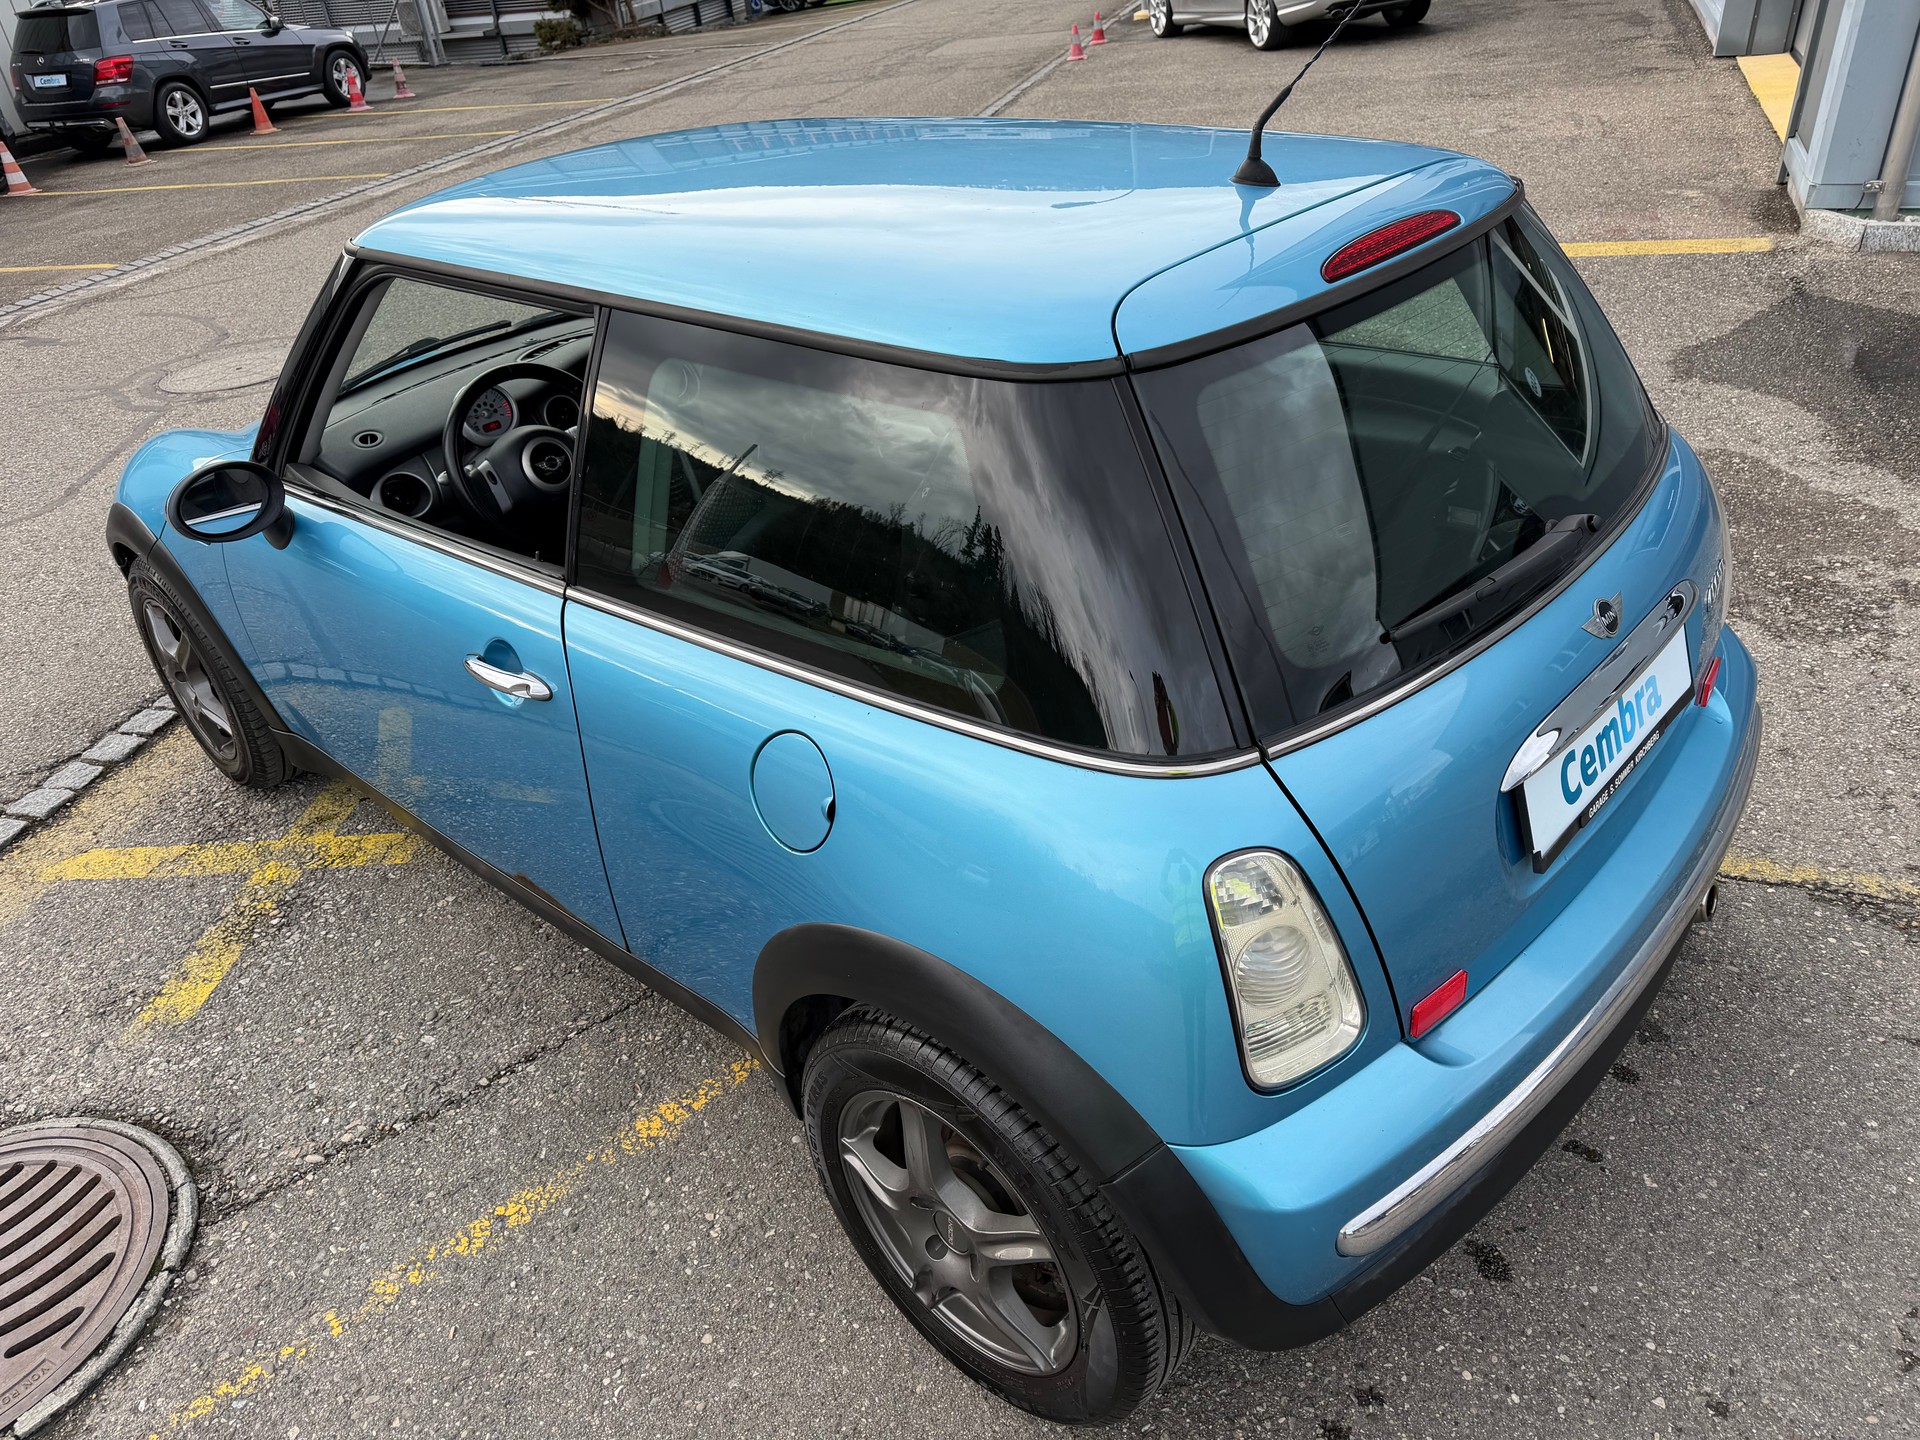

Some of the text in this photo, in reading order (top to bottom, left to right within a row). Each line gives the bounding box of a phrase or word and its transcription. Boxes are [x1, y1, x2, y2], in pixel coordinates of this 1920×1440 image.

[1560, 674, 1662, 805] Cembra
[1588, 789, 1609, 818] GARAGE
[1614, 760, 1635, 788] SOMMER
[1635, 730, 1660, 765] KIRCHBERG
